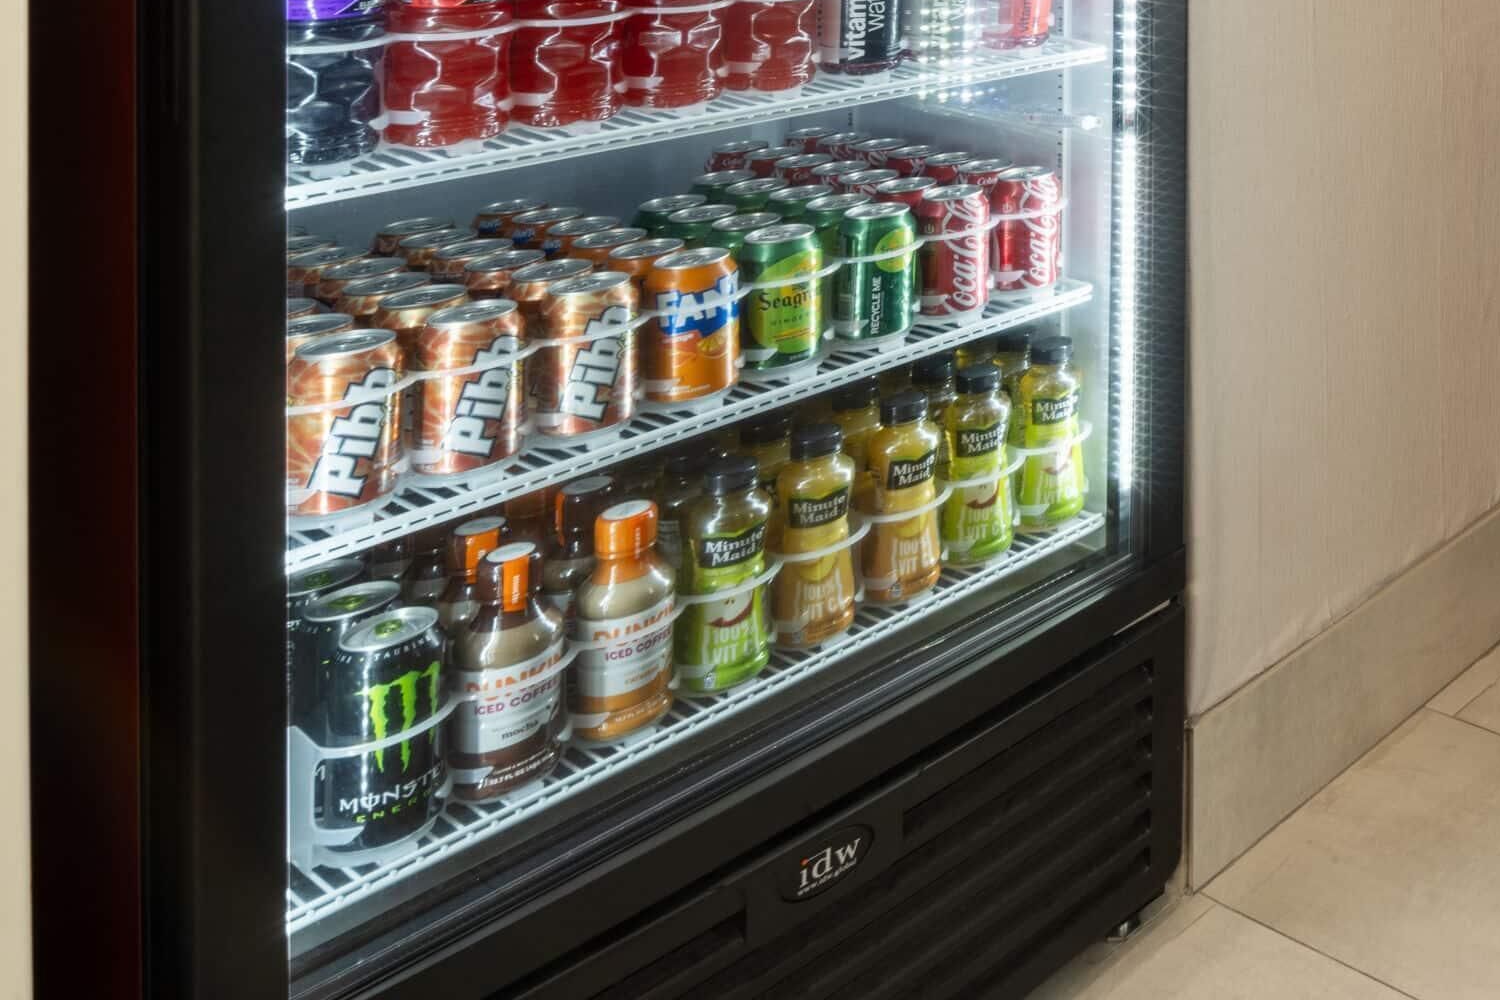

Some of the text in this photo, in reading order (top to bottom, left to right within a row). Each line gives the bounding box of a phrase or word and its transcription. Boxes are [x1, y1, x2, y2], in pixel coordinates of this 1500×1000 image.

[757, 287, 813, 312] Seagr
[869, 275, 882, 335] RECYCLE ME
[559, 304, 632, 423] Pibb
[443, 333, 520, 459] Pibb
[306, 366, 397, 499] Pibb
[892, 452, 938, 479] Minute
[791, 494, 848, 516] Minute
[799, 507, 840, 526] Maid
[703, 526, 765, 554] Minute
[710, 543, 757, 567] Maid
[604, 645, 633, 662] ICED
[474, 701, 505, 717] ICED
[338, 758, 447, 814] MONSTE
[355, 780, 440, 824] ENERG
[799, 837, 862, 889] idw
